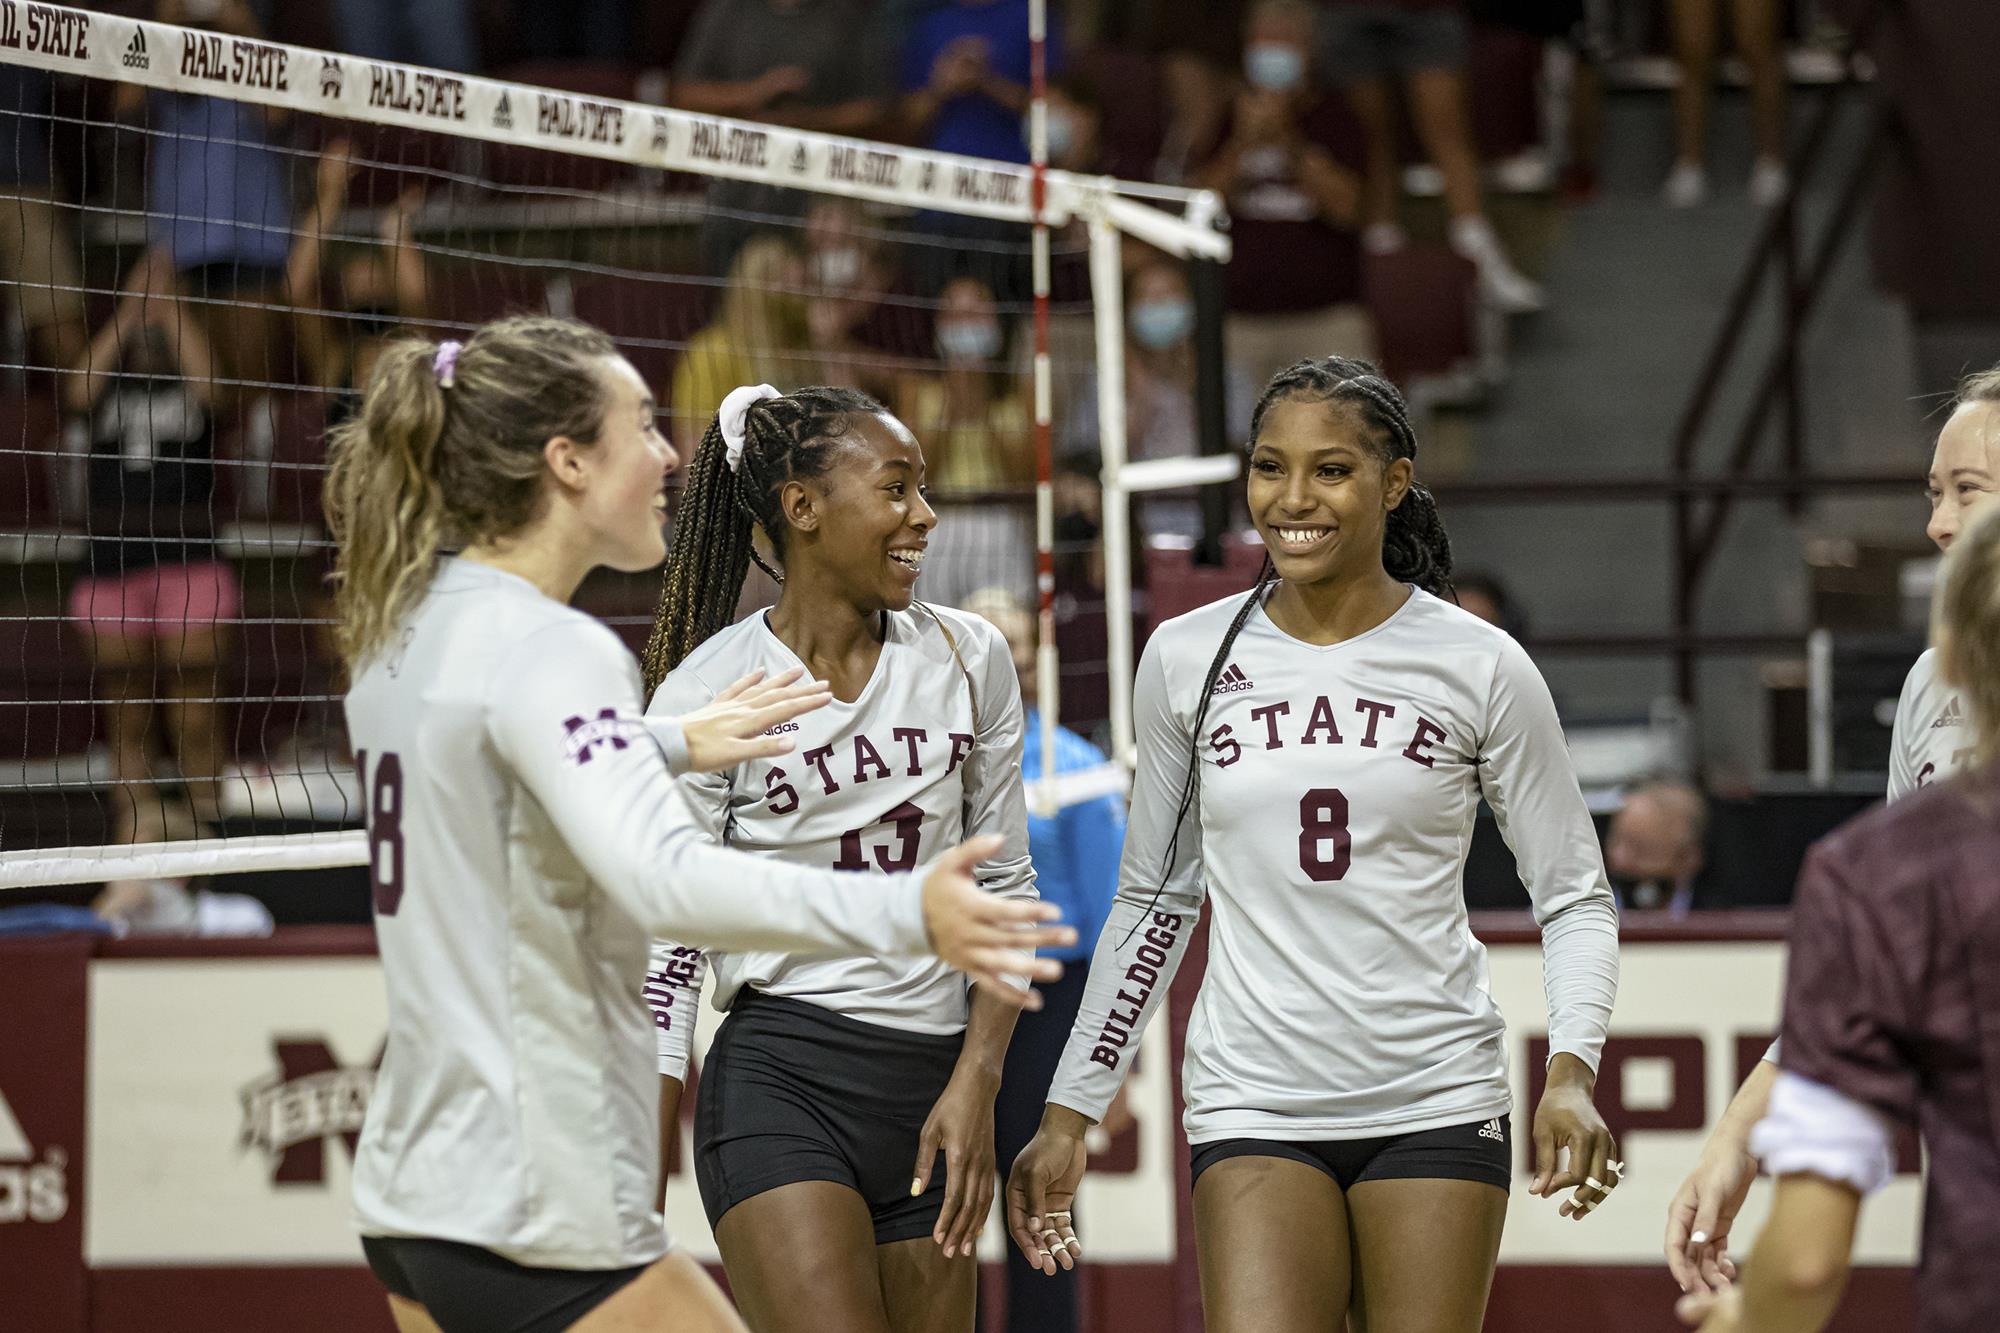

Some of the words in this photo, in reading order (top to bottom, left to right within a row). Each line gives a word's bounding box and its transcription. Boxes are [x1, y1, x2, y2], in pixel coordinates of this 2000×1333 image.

[26, 4, 90, 59] STATE
[122, 53, 150, 70] adidas
[180, 31, 228, 81] HAIL
[231, 40, 288, 91] STATE
[369, 64, 411, 110] HAIL
[414, 72, 466, 120] STATE
[579, 102, 624, 145] STATE
[1211, 681, 1254, 695] adidas
[762, 722, 800, 736] didas
[1209, 695, 1449, 769] STATE
[764, 727, 976, 816] STATE
[833, 801, 926, 873] 13
[1299, 788, 1352, 882] 8
[1089, 912, 1183, 1072] BULLDOGS
[1478, 1129, 1503, 1142] adidas
